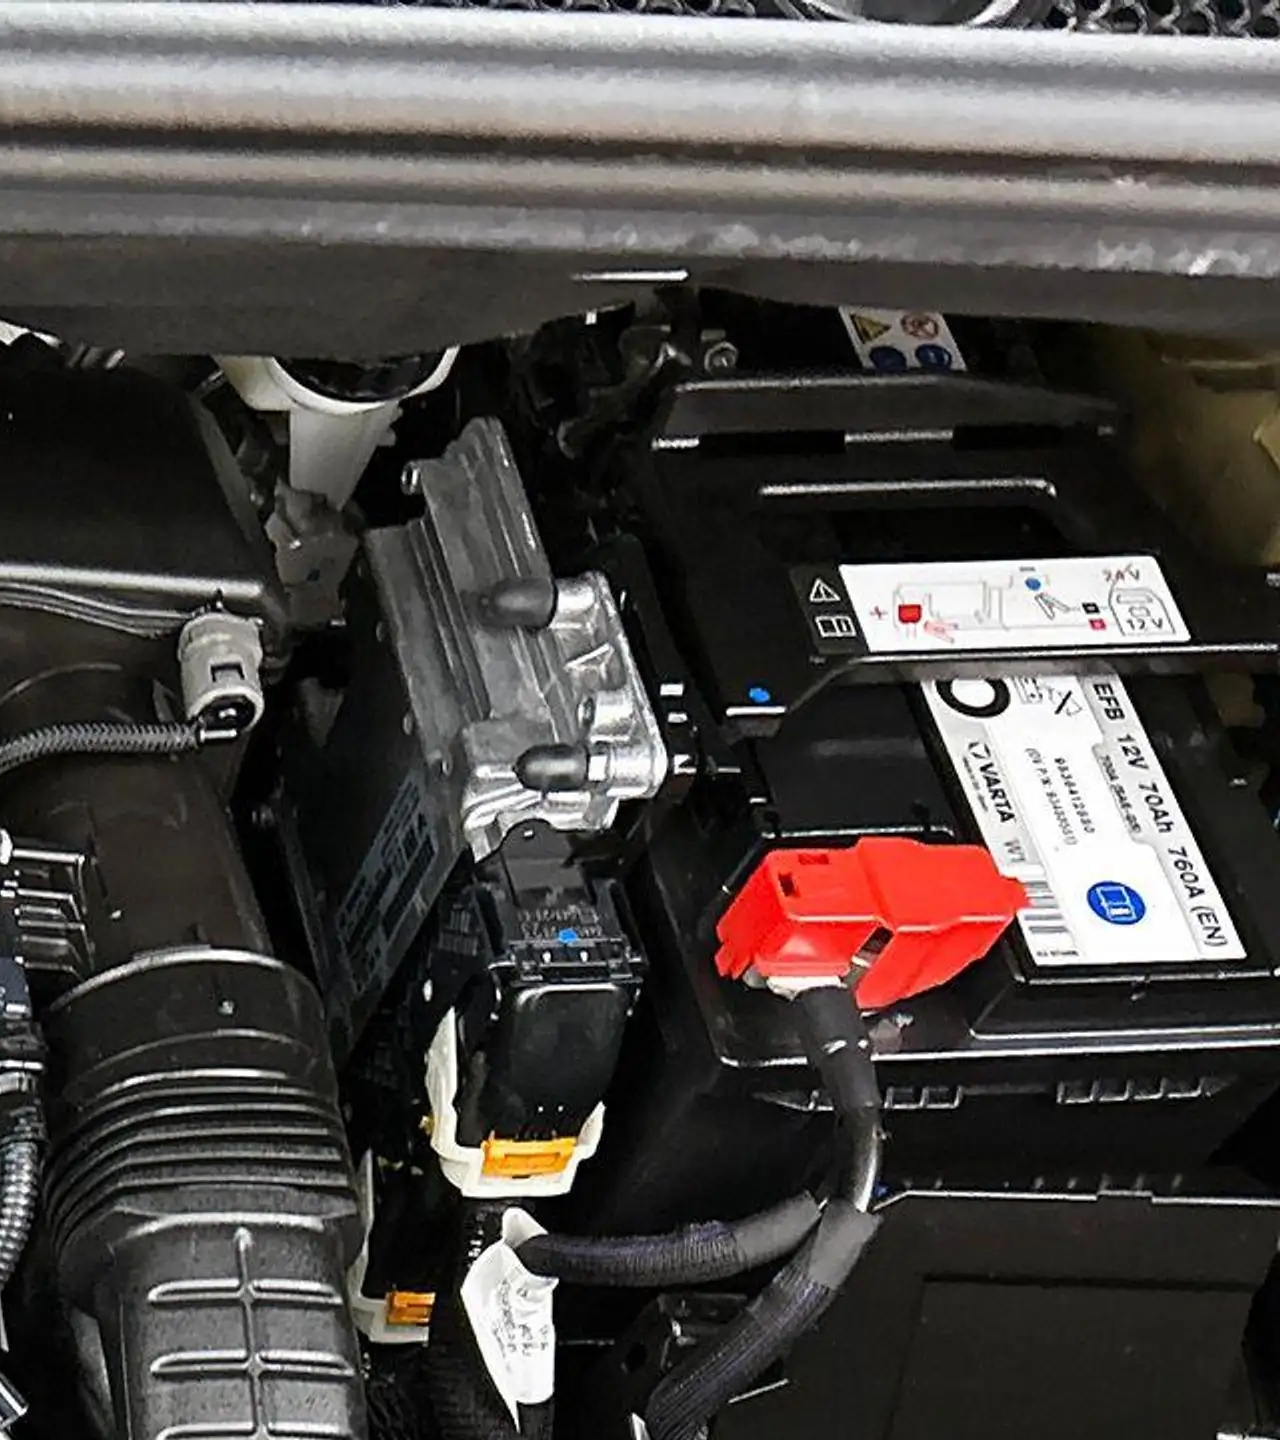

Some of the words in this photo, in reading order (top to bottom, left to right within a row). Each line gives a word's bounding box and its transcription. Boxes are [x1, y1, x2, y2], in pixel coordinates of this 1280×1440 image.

[1151, 617, 1165, 632] V
[979, 762, 1016, 823] VARTA
[1092, 683, 1125, 720] EFB
[1116, 734, 1149, 770] 12V
[1138, 782, 1175, 833] 70Ah
[1168, 846, 1206, 899] 760A
[1190, 904, 1229, 947] (EN)
